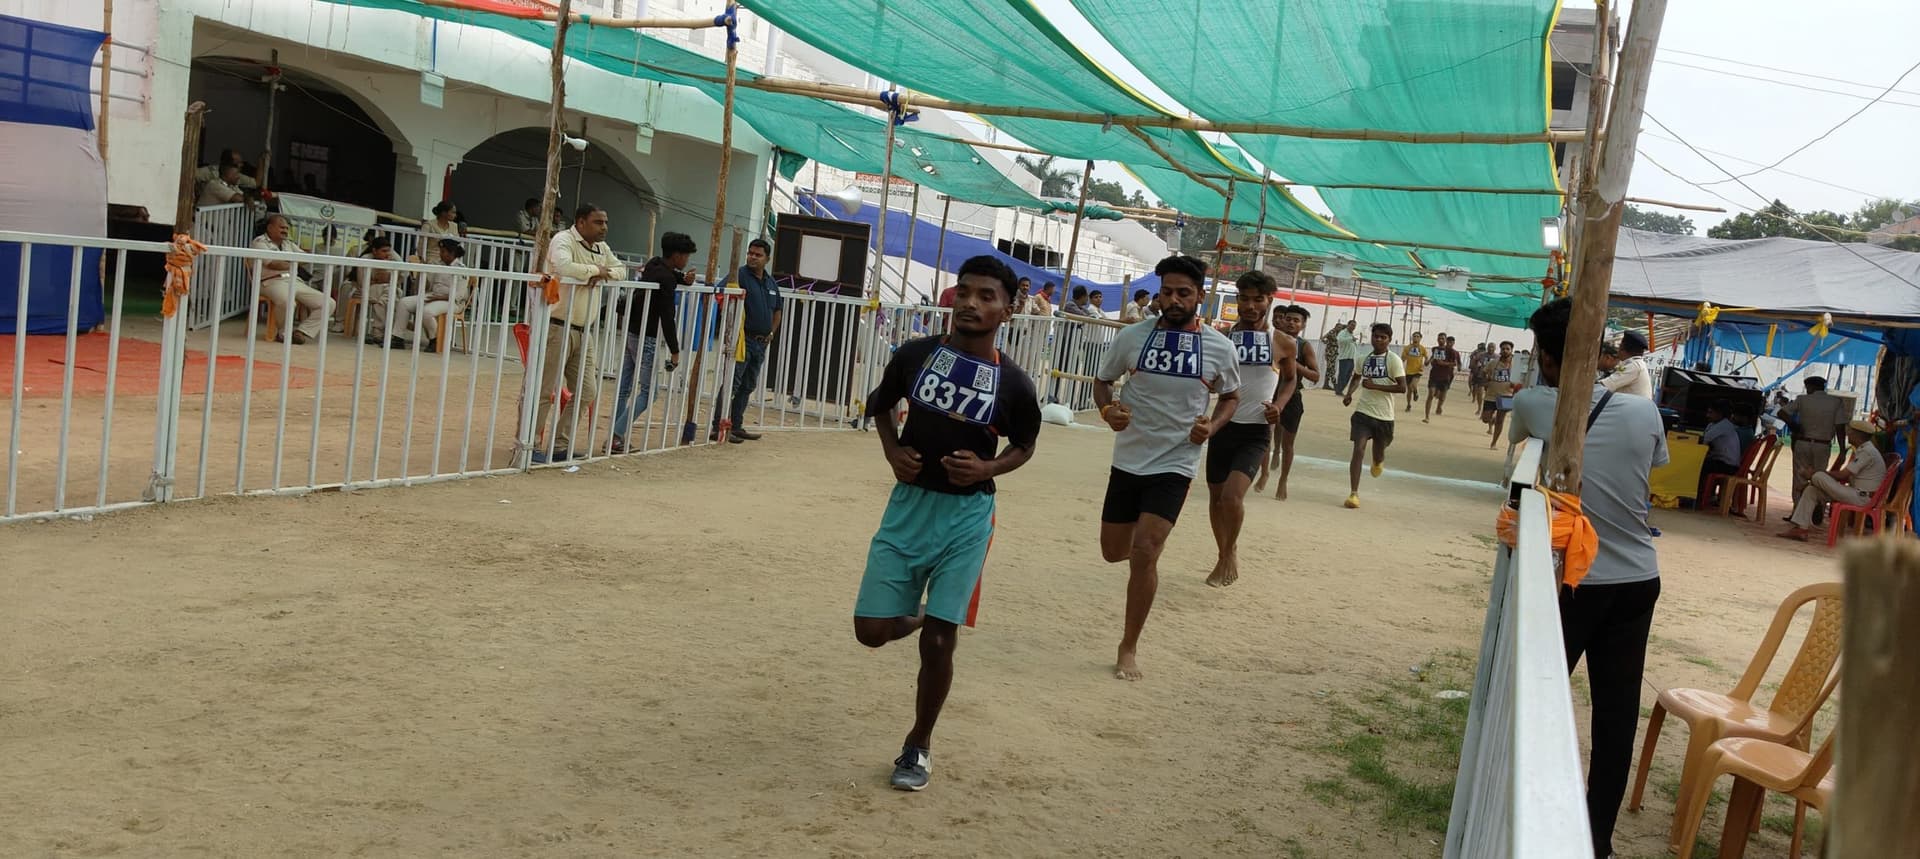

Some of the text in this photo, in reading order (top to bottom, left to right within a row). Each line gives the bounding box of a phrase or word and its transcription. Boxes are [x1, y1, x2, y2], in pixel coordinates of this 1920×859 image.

[1144, 348, 1197, 374] 8311
[1237, 345, 1270, 362] 015
[1363, 365, 1386, 377] 8447
[919, 373, 994, 420] 8377
